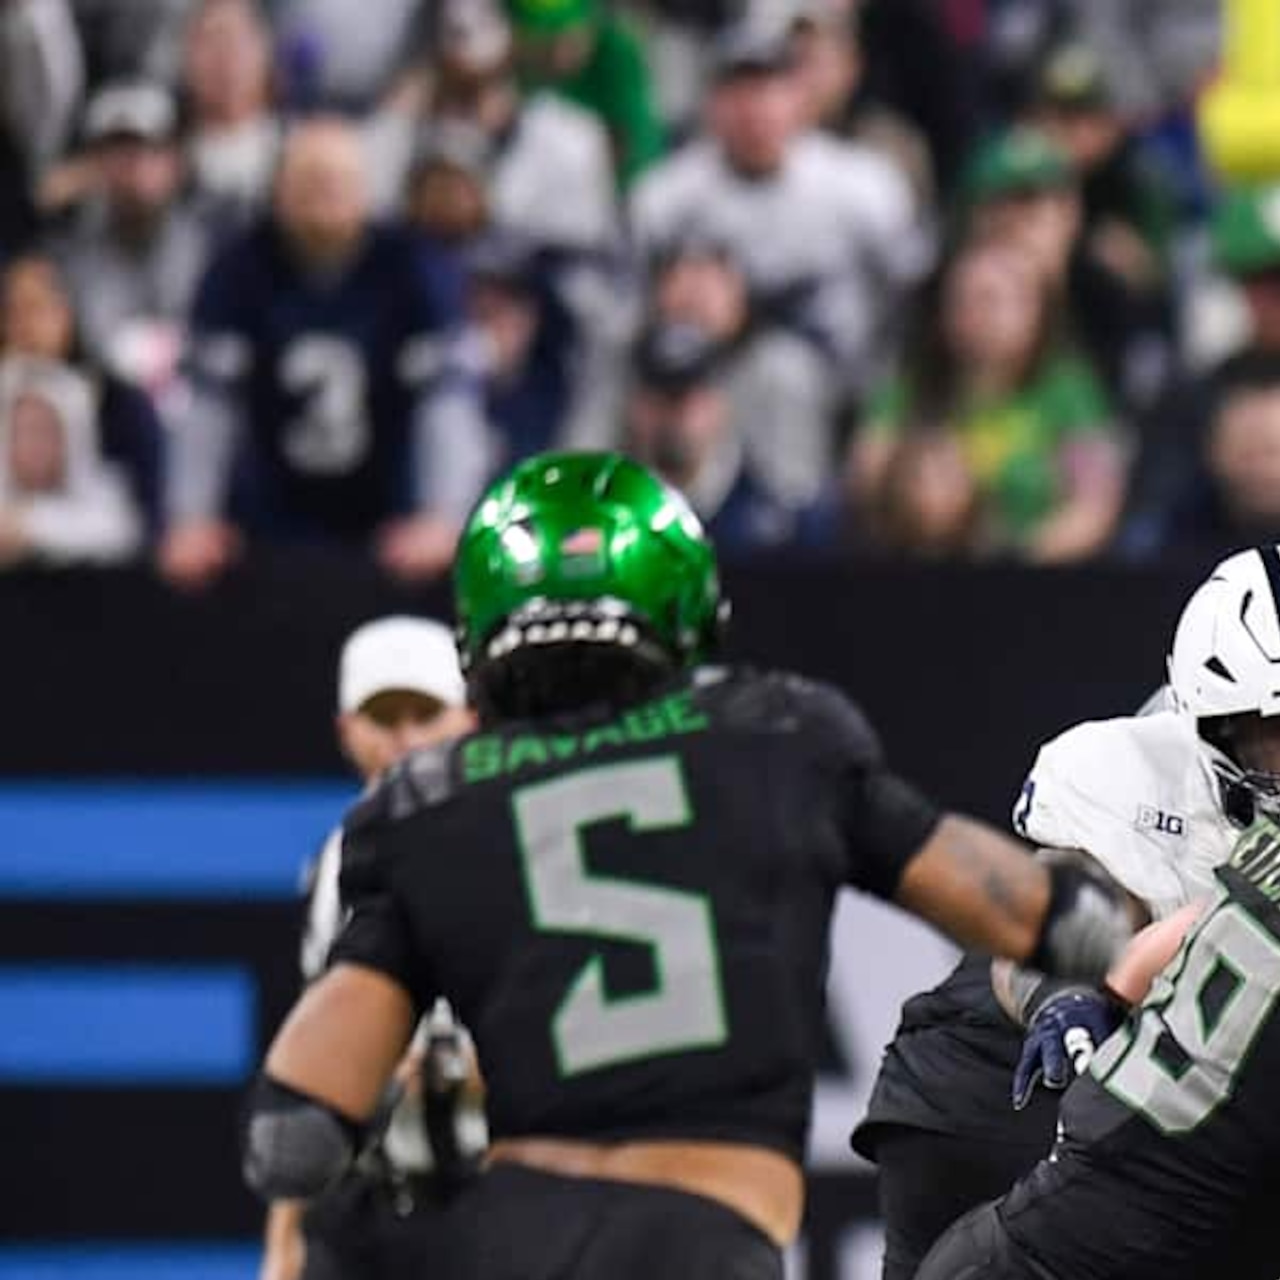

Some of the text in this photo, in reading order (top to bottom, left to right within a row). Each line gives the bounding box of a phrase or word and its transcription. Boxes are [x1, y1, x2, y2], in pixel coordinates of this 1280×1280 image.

[276, 332, 371, 478] 3
[462, 690, 710, 784] SAVAGE
[1138, 803, 1184, 835] B1G
[511, 751, 729, 1080] 5
